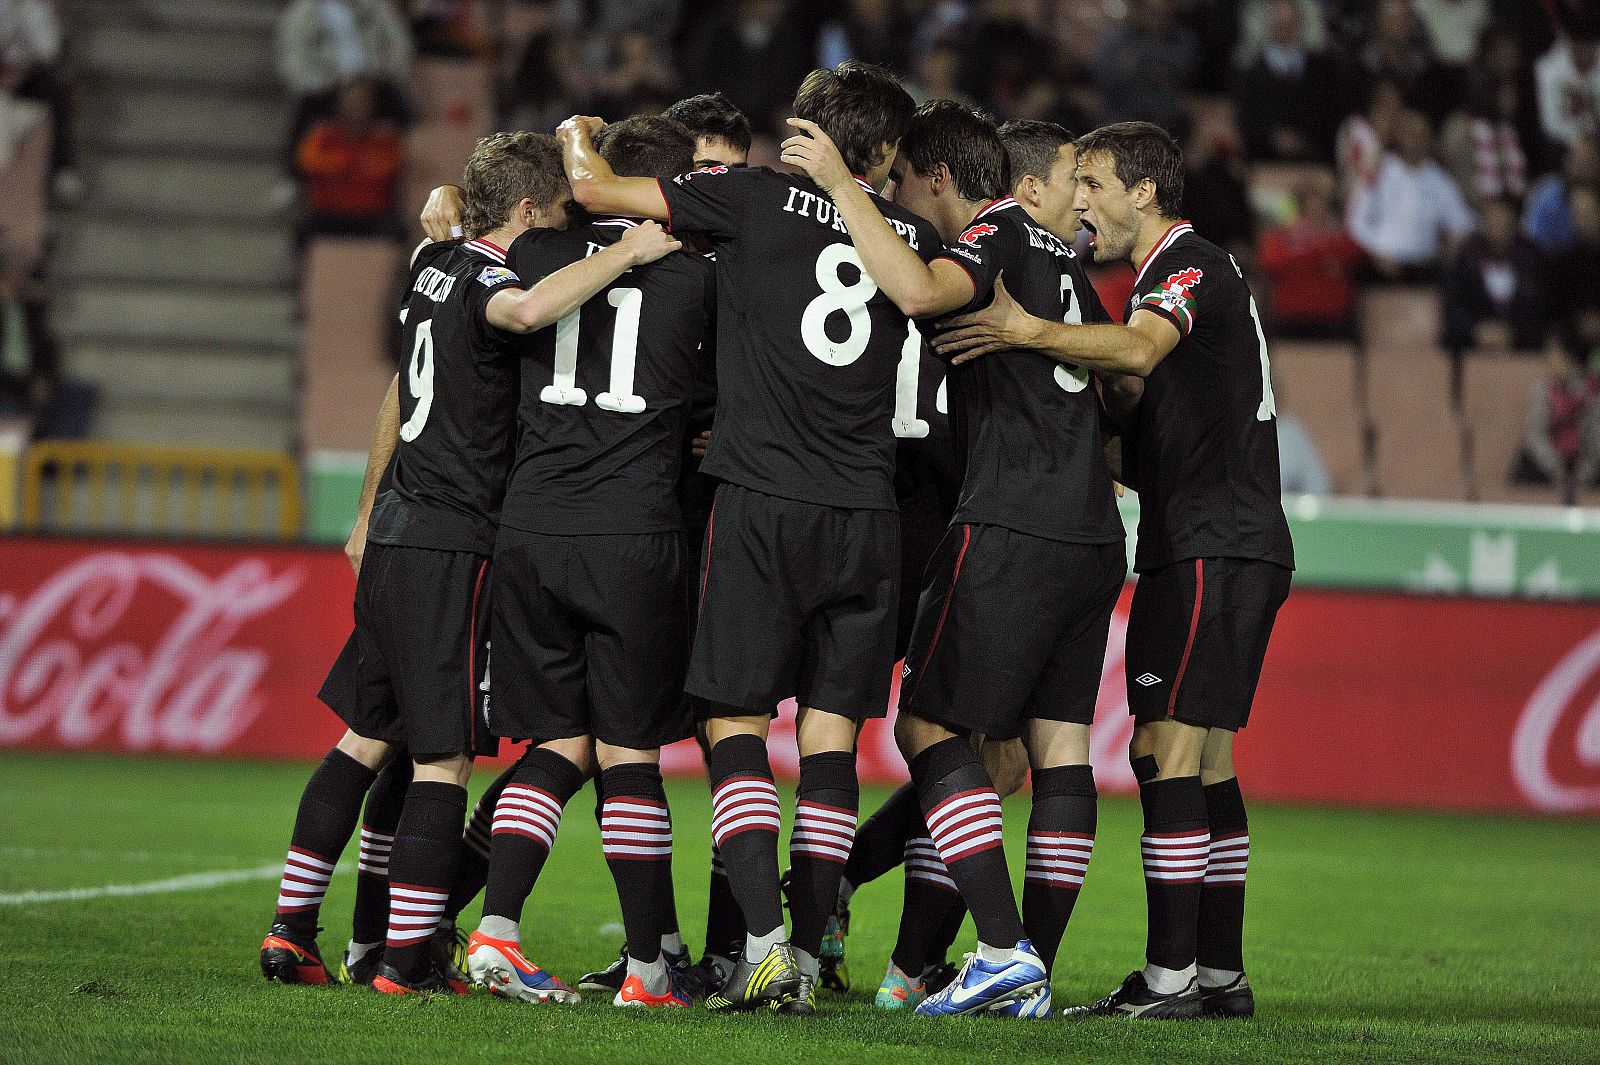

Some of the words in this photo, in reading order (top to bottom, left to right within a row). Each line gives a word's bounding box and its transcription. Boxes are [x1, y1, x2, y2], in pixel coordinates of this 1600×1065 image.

[783, 186, 919, 251] ITURPE
[540, 287, 647, 413] 11
[800, 242, 878, 367] 8
[400, 308, 434, 442] 9
[891, 317, 949, 438] 1
